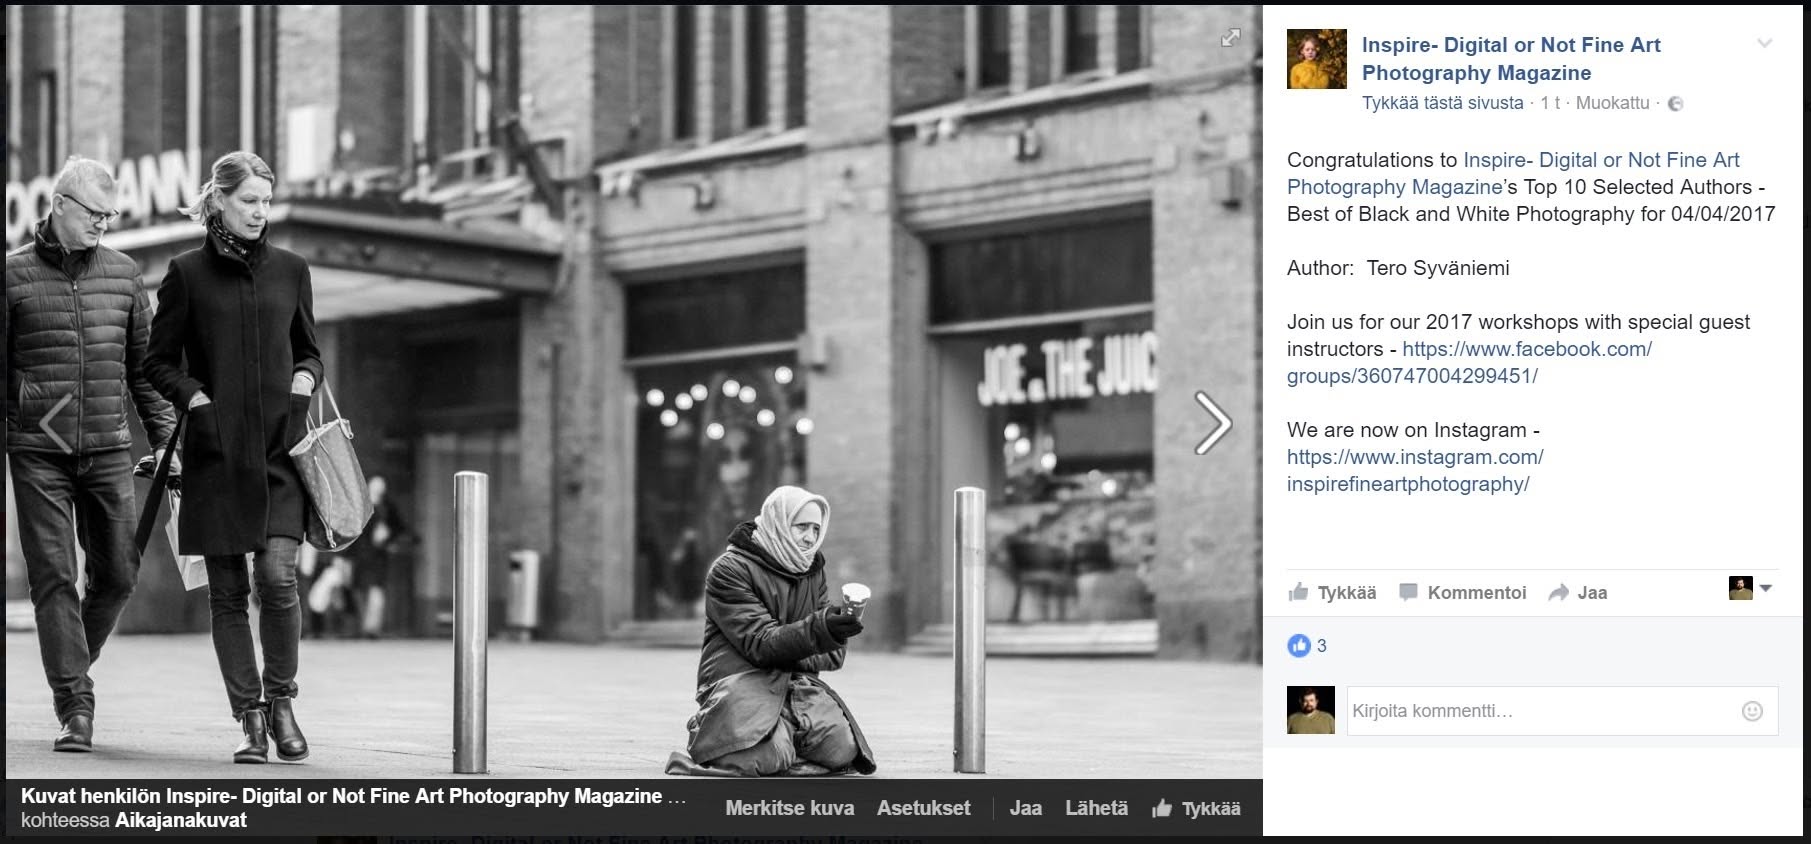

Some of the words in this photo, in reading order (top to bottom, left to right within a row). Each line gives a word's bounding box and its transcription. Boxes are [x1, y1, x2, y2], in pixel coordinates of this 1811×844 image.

[1363, 37, 1438, 56] Inspire-
[1445, 37, 1507, 56] Digital
[1515, 41, 1535, 52] or
[1542, 37, 1576, 52] Not
[1582, 37, 1624, 52] Fine
[1630, 37, 1661, 52] Art
[1363, 65, 1492, 84] Photography
[1498, 65, 1592, 84] Magazine
[1362, 96, 1419, 113] Tykkää
[1424, 96, 1463, 109] tästä
[1468, 96, 1523, 109] sivusta
[1542, 96, 1547, 109] 1
[1555, 96, 1560, 109] t
[1577, 96, 1649, 109] Muokattu
[1288, 152, 1433, 171] Congratulations
[1440, 152, 1457, 167] to
[1465, 152, 1533, 171] Inspire-
[1540, 152, 1596, 171] Digital
[1604, 156, 1623, 167] or
[1629, 152, 1661, 167] Not
[1668, 152, 1707, 167] Fine
[1713, 152, 1740, 167] Art
[1288, 179, 1406, 198] Photography
[1524, 179, 1557, 198] Top
[1565, 179, 1586, 194] 10
[1593, 179, 1673, 194] Selected
[1680, 179, 1752, 194] Authors
[1288, 206, 1329, 221] Best
[1335, 206, 1353, 221] of
[1360, 206, 1410, 221] Black
[1416, 206, 1449, 221] and
[1456, 206, 1510, 221] White
[1517, 206, 1635, 225] Photography
[1641, 206, 1666, 221] for
[1672, 206, 1776, 221] 04/04/2017
[1287, 260, 1353, 275] Author:
[1367, 260, 1407, 275] Tero
[1414, 260, 1509, 279] Syväniemi
[1287, 314, 1324, 329] Join
[1332, 318, 1353, 329] us
[1359, 314, 1384, 329] for
[1390, 318, 1420, 329] our
[1426, 314, 1472, 329] 2017
[1478, 314, 1578, 333] workshops
[1585, 314, 1621, 329] with
[1628, 314, 1692, 333] special
[1699, 314, 1751, 333] guest
[1288, 341, 1383, 356] instructors
[1404, 341, 1652, 360] https://www.facebook.com/
[1041, 337, 1094, 399] THE
[1288, 368, 1538, 387] groups/360747004299451/
[1287, 422, 1318, 437] We
[1324, 426, 1354, 437] are
[1361, 426, 1399, 437] now
[1405, 426, 1427, 437] on
[1435, 422, 1526, 441] Instagram
[1288, 449, 1544, 468] https://www.instagram.com/
[1288, 476, 1530, 495] inspirefineartphotography/
[1318, 586, 1376, 603] Tykkää
[1429, 586, 1526, 599] Kommentoi
[1578, 586, 1607, 599] Jaa
[1318, 639, 1326, 652] 3
[1353, 704, 1407, 721] Kirjoita
